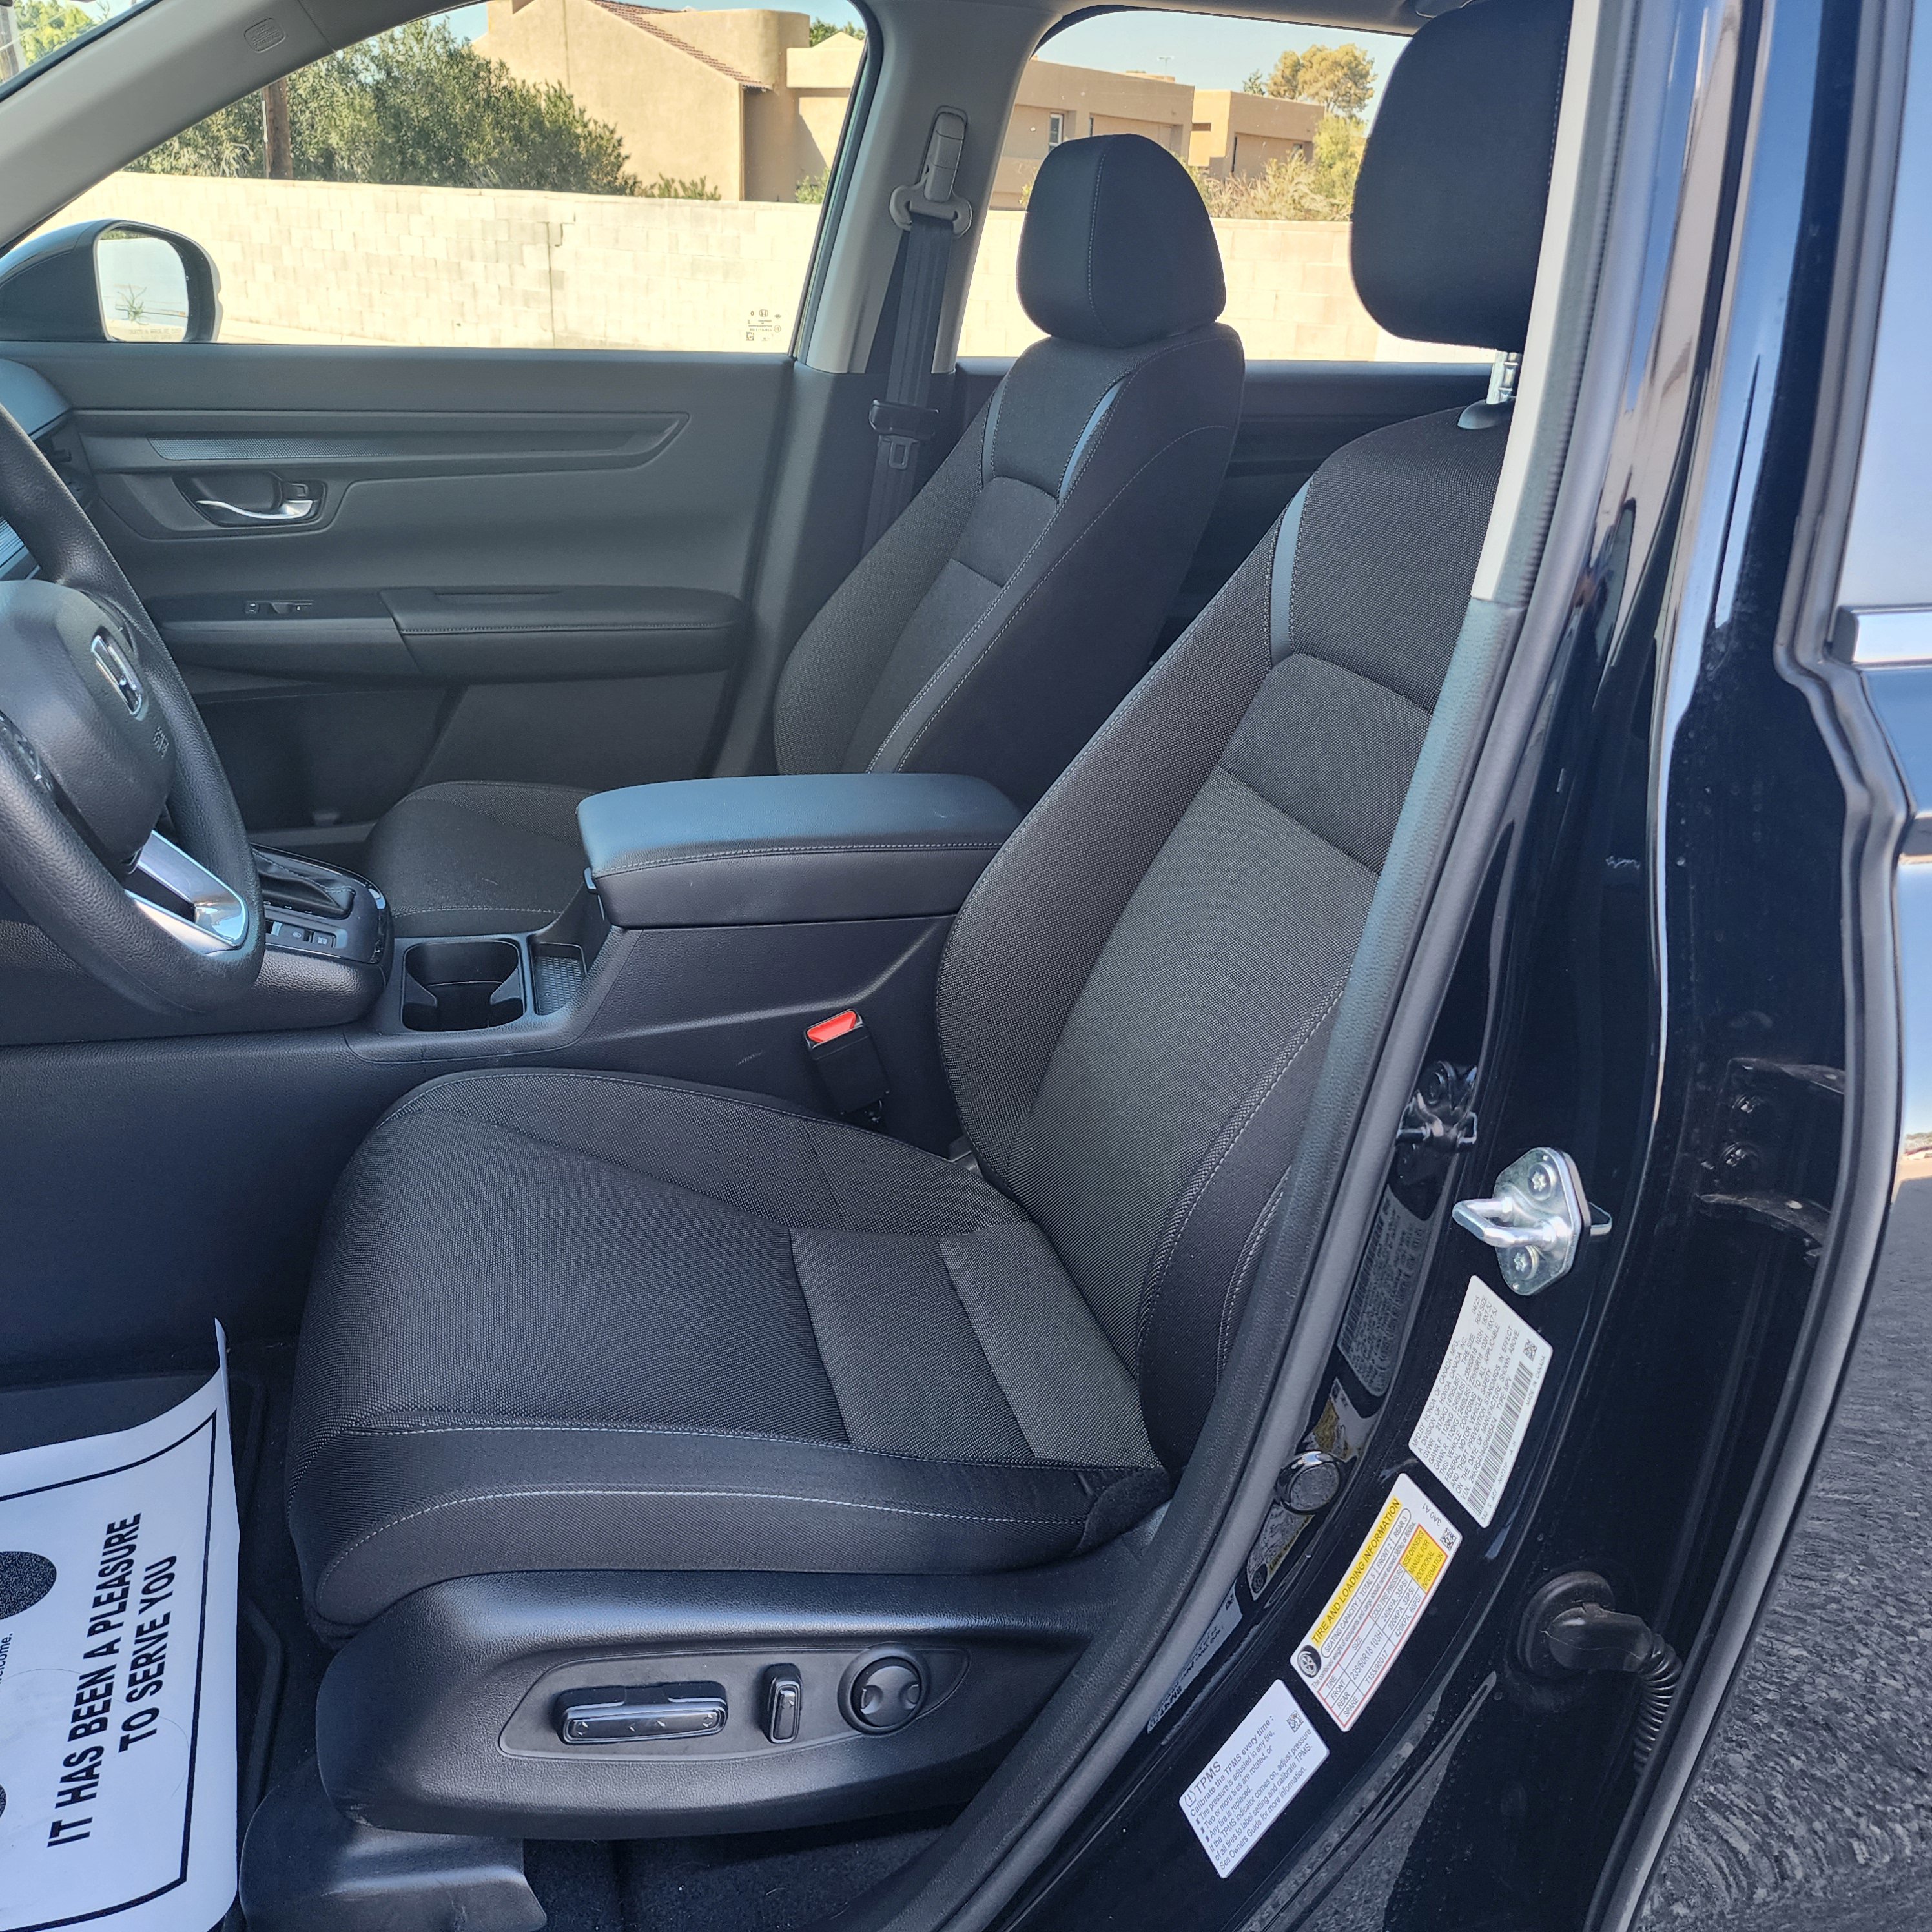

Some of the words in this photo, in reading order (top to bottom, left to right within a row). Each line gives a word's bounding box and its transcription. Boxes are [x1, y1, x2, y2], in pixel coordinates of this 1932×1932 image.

[1423, 1437, 1435, 1459] GVWR
[1421, 1502, 1431, 1514] A1
[1429, 1510, 1442, 1526] 3A0
[87, 1512, 141, 1638] PLEASURE
[1311, 1619, 1329, 1644] TIRE
[1326, 1601, 1341, 1624] AND
[1338, 1560, 1365, 1603] LOADING
[1361, 1497, 1401, 1563] INFORMATION
[1401, 1554, 1411, 1567] SEE
[1408, 1551, 1423, 1574] MANUAL
[1420, 1539, 1430, 1553] FOR
[1414, 1549, 1435, 1581] ADDITIONAL
[1421, 1551, 1444, 1589] INFORMATION
[138, 1556, 177, 1615] YOU
[1324, 1627, 1342, 1654] SEATING
[1339, 1599, 1359, 1630] CAPACITY
[1359, 1577, 1373, 1597] TOTAL
[1375, 1548, 1390, 1569] FRONT
[1392, 1519, 1405, 1538] REAR
[1371, 1603, 1382, 1619] COLD
[1379, 1592, 1388, 1605] TIRE
[1384, 1566, 1404, 1596] PRESSURE
[1381, 1596, 1398, 1622] 240KPA,
[1395, 1578, 1408, 1598] 35PSI
[1387, 1604, 1405, 1630] 220KPA,
[1402, 1585, 1415, 1605] 32PSI
[1394, 1612, 1412, 1638] 420KPA,
[1408, 1593, 1422, 1613] 60PSI
[0, 1633, 13, 1684] come.
[83, 1636, 121, 1659] A
[125, 1611, 170, 1703] SERVE
[1350, 1645, 1373, 1681] 235/60R18
[1370, 1629, 1383, 1649] 103H
[1351, 1635, 1362, 1650] SIZE
[1326, 1674, 1337, 1689] TIRE
[1330, 1678, 1346, 1701] FRONT
[1365, 1649, 1388, 1685] T155/90D17
[68, 1663, 117, 1742] BEEN
[1337, 1690, 1350, 1709] REAR
[1343, 1695, 1359, 1718] SPARE
[118, 1707, 160, 1753] TO
[55, 1745, 104, 1809] HAS
[1189, 1785, 1215, 1817] Calibrate
[1214, 1774, 1225, 1787] the
[1223, 1752, 1242, 1775] TPMS
[1240, 1734, 1258, 1756] every
[1256, 1719, 1270, 1736] time
[1193, 1760, 1221, 1794] TPMS
[1198, 1806, 1209, 1820] Tire
[1208, 1784, 1229, 1811] pressure
[1226, 1778, 1233, 1787] is
[1231, 1755, 1252, 1782] adjusted
[1249, 1750, 1257, 1758] in
[1255, 1739, 1266, 1753] any
[1263, 1729, 1275, 1742] tire,
[1204, 1814, 1215, 1829] Two
[1214, 1807, 1220, 1817] or
[1220, 1794, 1233, 1811] more
[1231, 1782, 1242, 1796] tires
[1241, 1773, 1250, 1785] are
[1249, 1752, 1268, 1775] rotated,
[1266, 1745, 1273, 1754] or
[1209, 1843, 1215, 1853] If
[1213, 1835, 1222, 1847] the
[1220, 1817, 1237, 1838] TPMS
[1235, 1795, 1255, 1822] indicator
[1254, 1778, 1270, 1798] comes
[1269, 1769, 1279, 1781] on,
[1276, 1751, 1293, 1772] adjust
[1290, 1728, 1311, 1756] pressure
[1209, 1824, 1220, 1839] Any
[1218, 1814, 1228, 1827] tire
[1226, 1809, 1232, 1818] is
[1230, 1784, 1253, 1813] replaced.
[1214, 1850, 1221, 1861] of
[1225, 1833, 1237, 1848] tires
[1235, 1826, 1242, 1836] to
[1240, 1812, 1253, 1830] label
[1252, 1794, 1269, 1817] setting
[1267, 1783, 1278, 1798] and
[1276, 1761, 1297, 1787] calibrate
[1294, 1742, 1312, 1763] TPMS.
[1219, 1856, 1230, 1870] See
[1229, 1834, 1248, 1858] Owners
[1246, 1818, 1262, 1837] Guide
[1260, 1809, 1269, 1821] for
[1267, 1796, 1280, 1813] more
[1278, 1765, 1306, 1798] information.
[47, 1817, 93, 1847] IT
